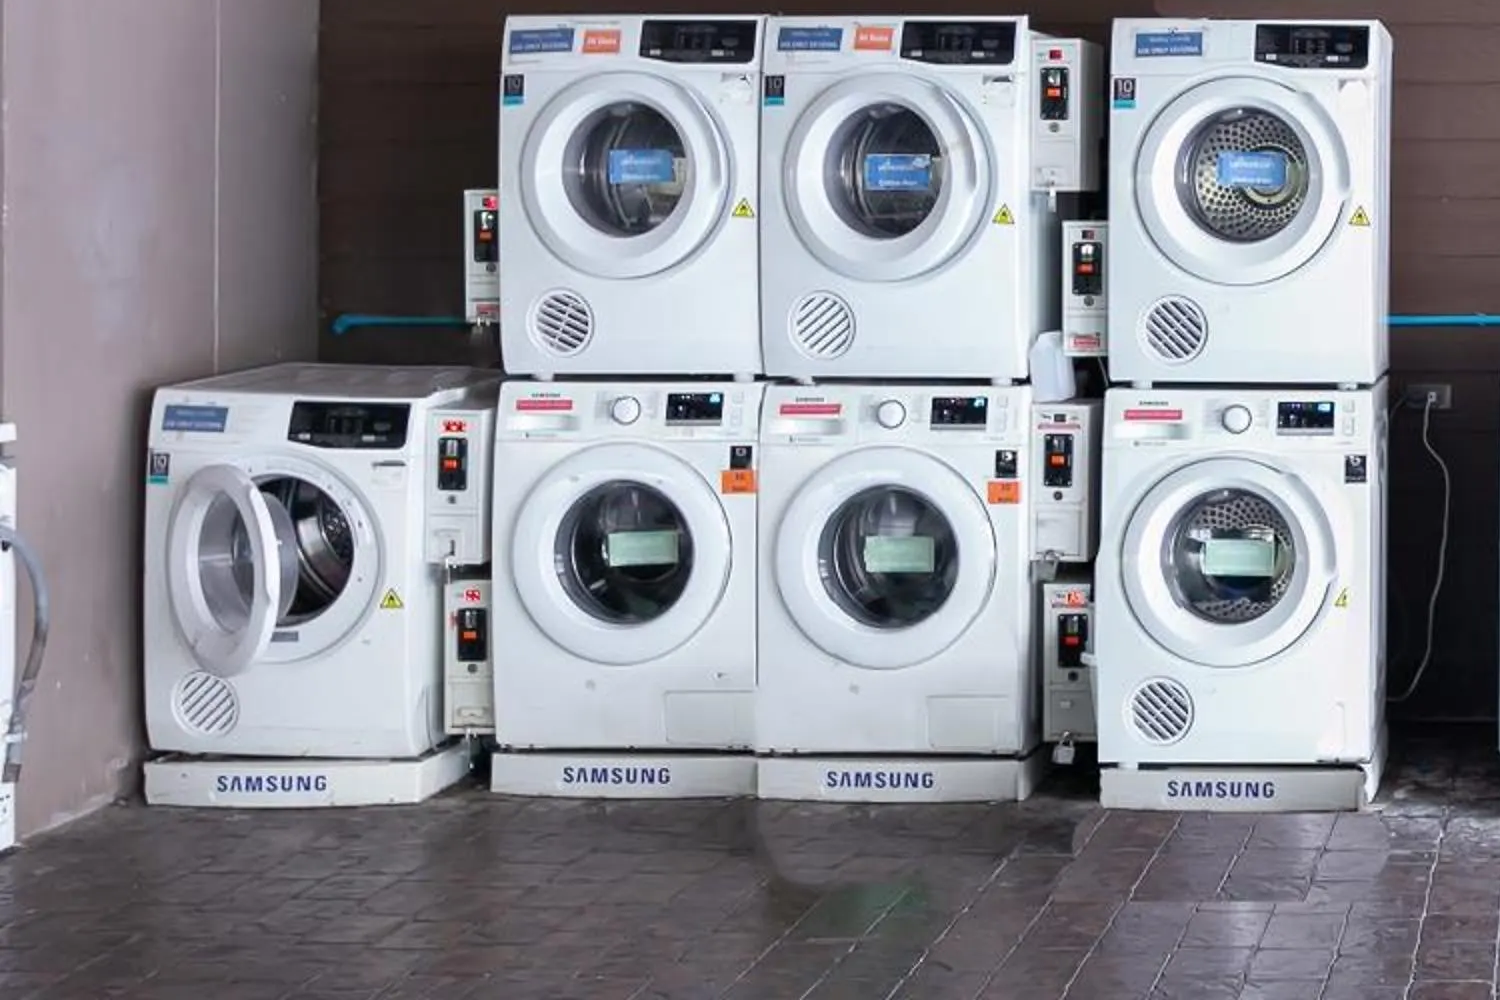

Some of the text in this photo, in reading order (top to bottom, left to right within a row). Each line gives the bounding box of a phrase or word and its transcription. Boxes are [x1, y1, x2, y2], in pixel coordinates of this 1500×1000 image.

[1117, 79, 1133, 93] 10
[216, 775, 327, 793] SAMSUNG
[562, 766, 671, 785] SAMSUNG
[826, 770, 934, 789] SAMSUNG
[1167, 780, 1275, 799] SAMSUNG
